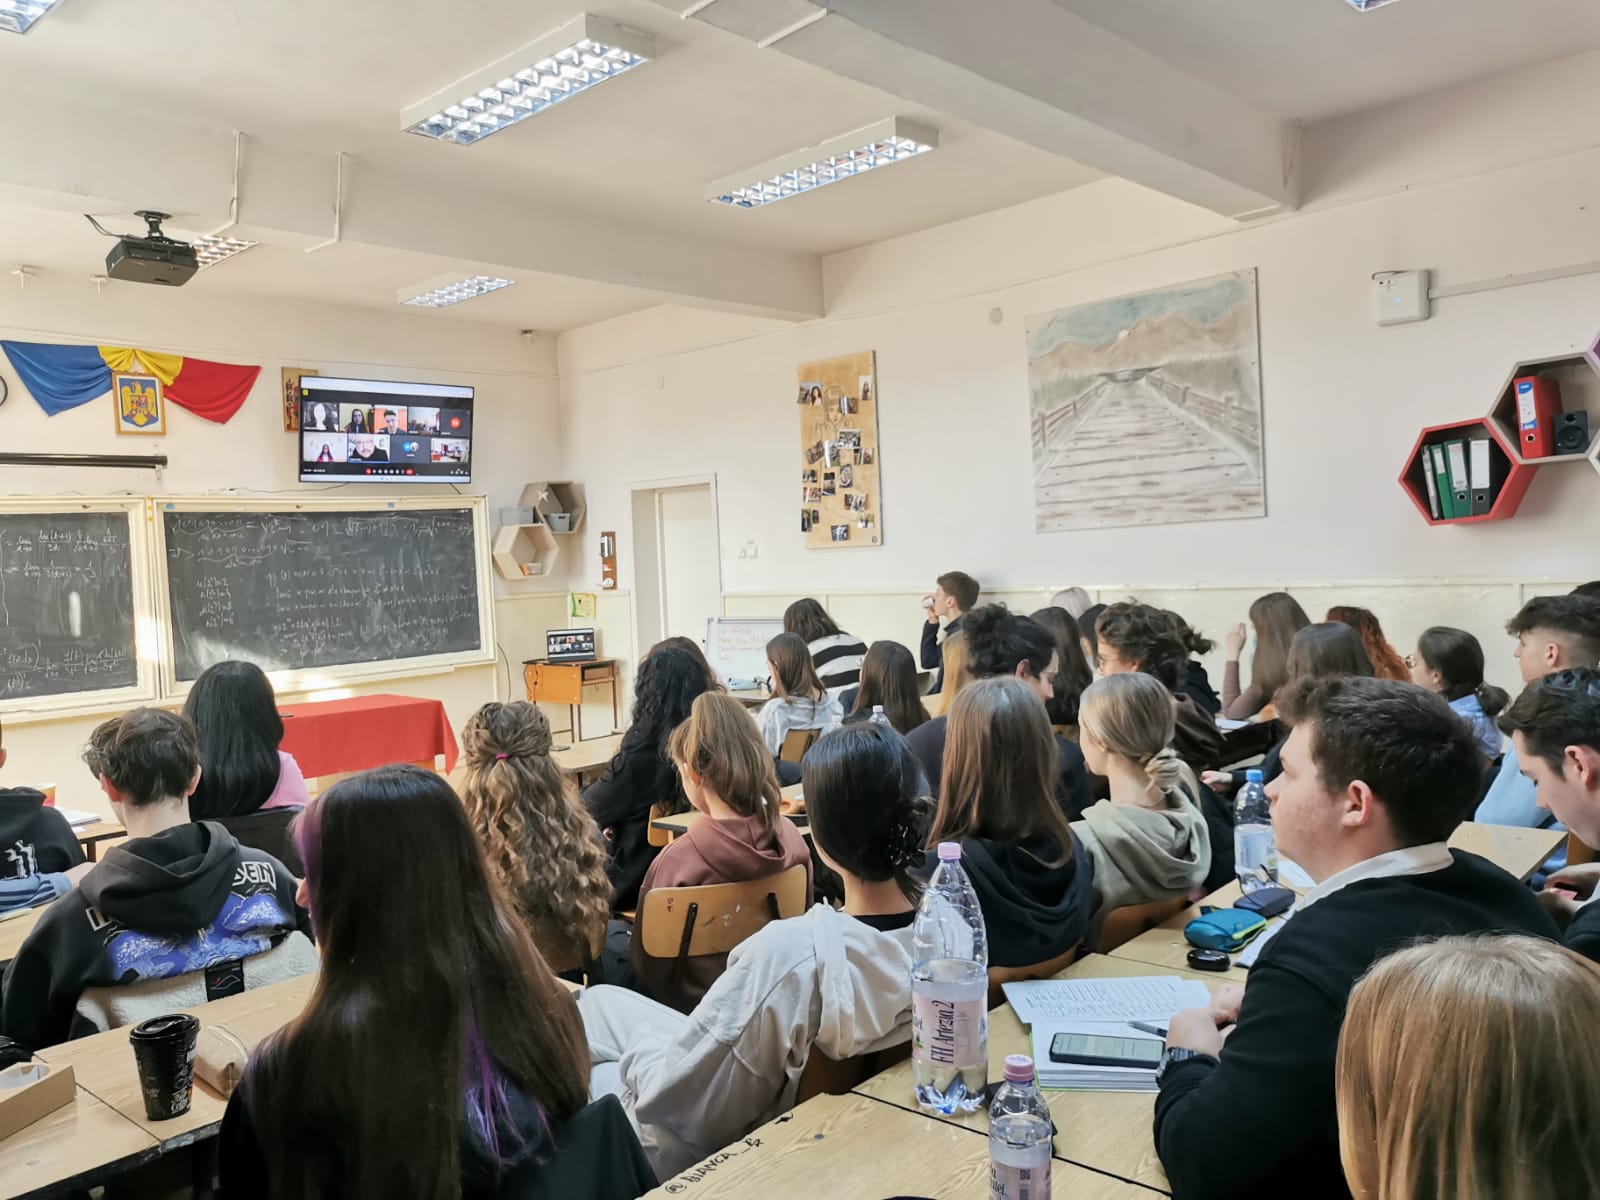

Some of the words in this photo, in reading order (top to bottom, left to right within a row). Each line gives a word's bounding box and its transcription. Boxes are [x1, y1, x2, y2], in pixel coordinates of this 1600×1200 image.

[932, 1000, 954, 1009] 2
[932, 1008, 954, 1046] Artezia
[931, 1045, 954, 1065] FH
